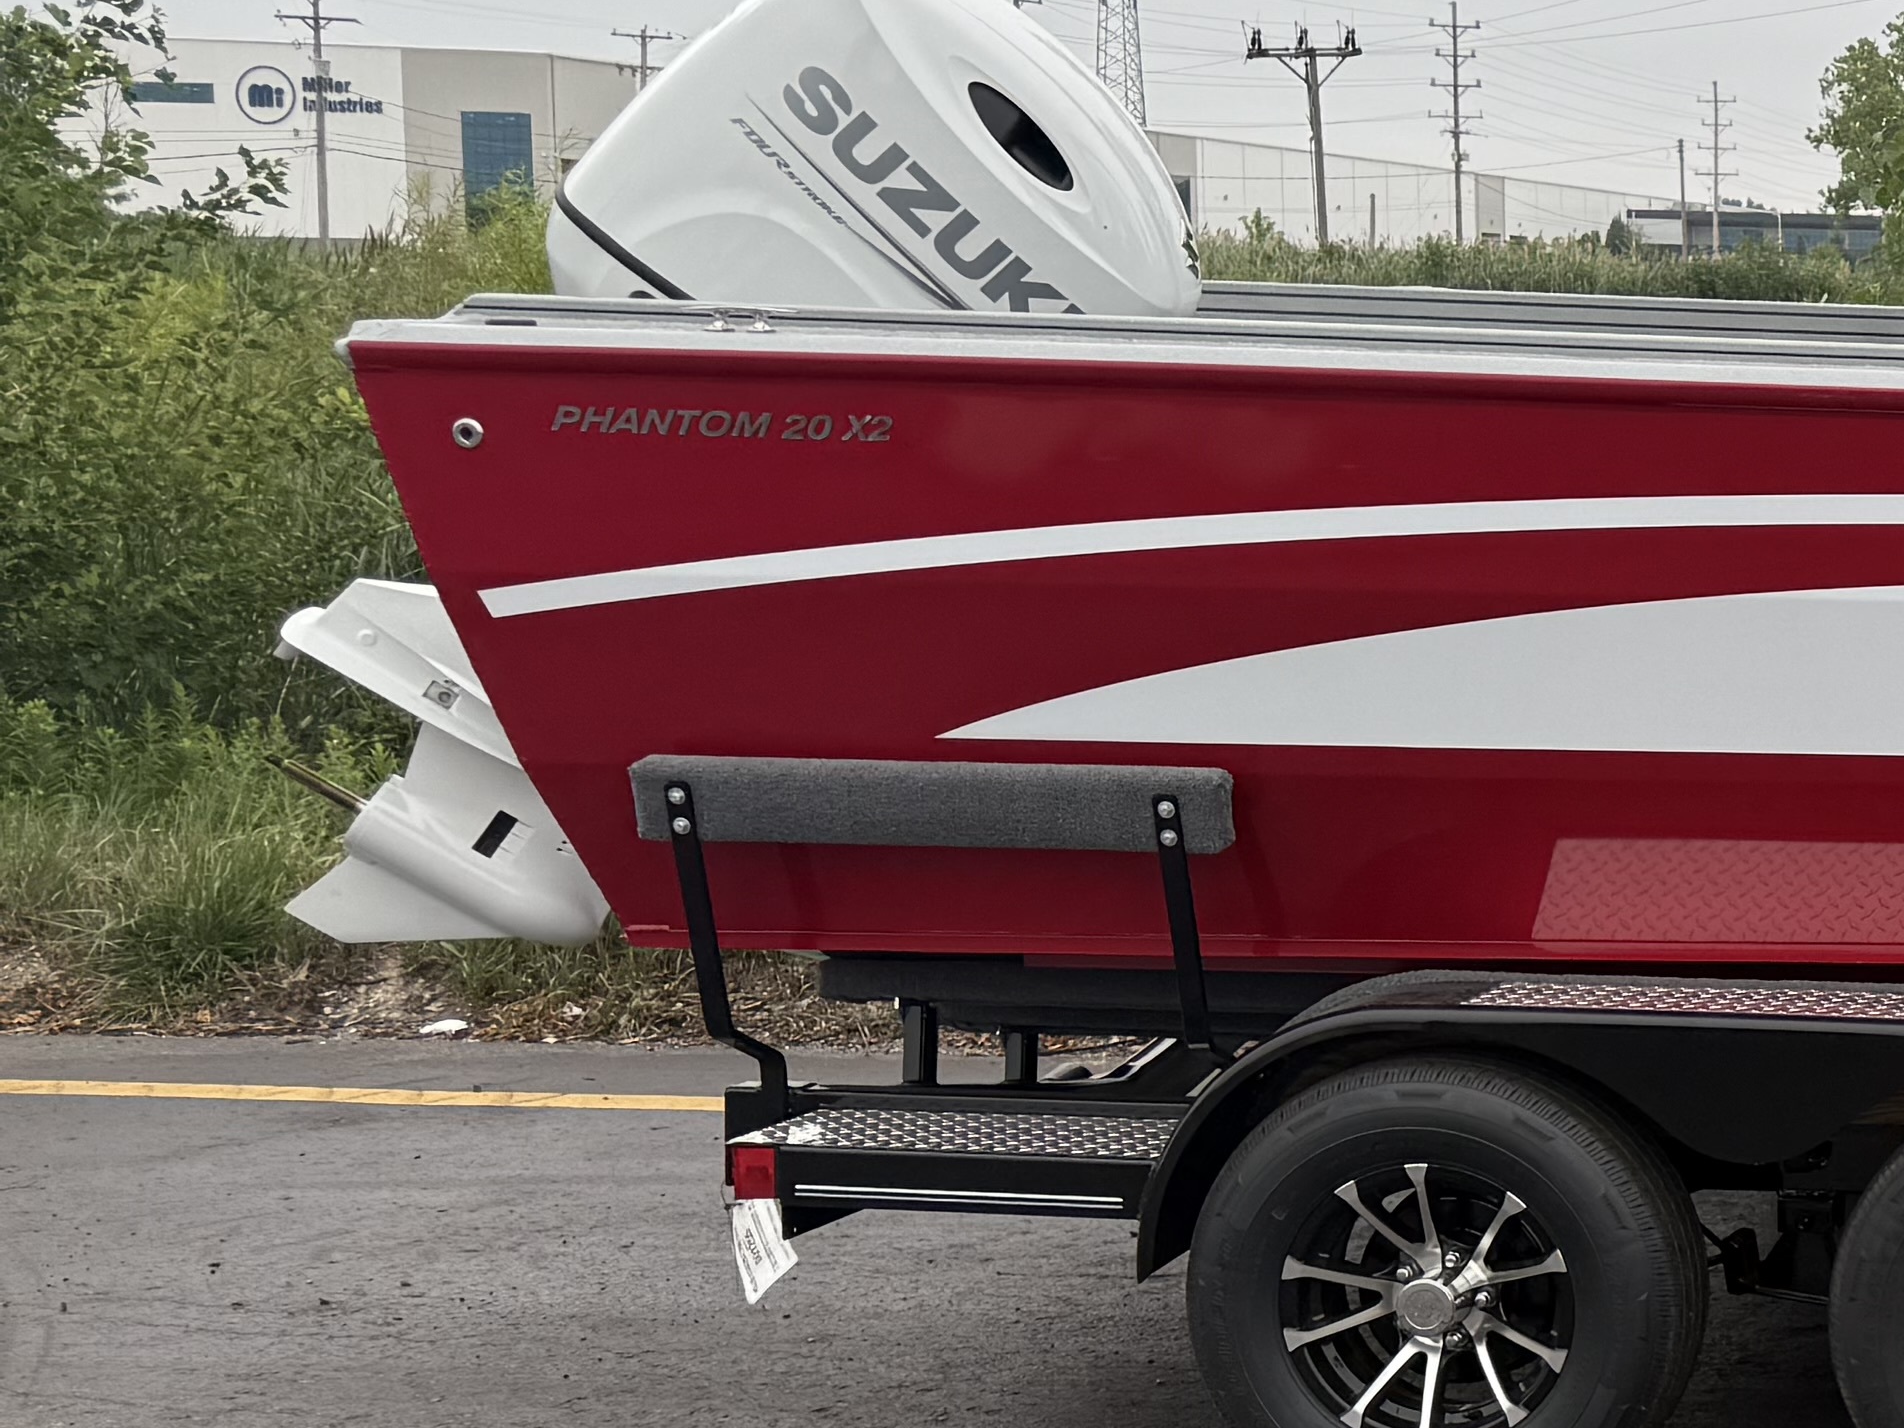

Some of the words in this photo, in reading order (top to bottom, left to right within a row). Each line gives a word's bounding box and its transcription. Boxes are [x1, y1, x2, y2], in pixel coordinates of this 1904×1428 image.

[302, 76, 351, 93] Mller
[551, 404, 772, 439] PHANTOM
[781, 414, 834, 441] 20
[841, 414, 893, 442] X2
